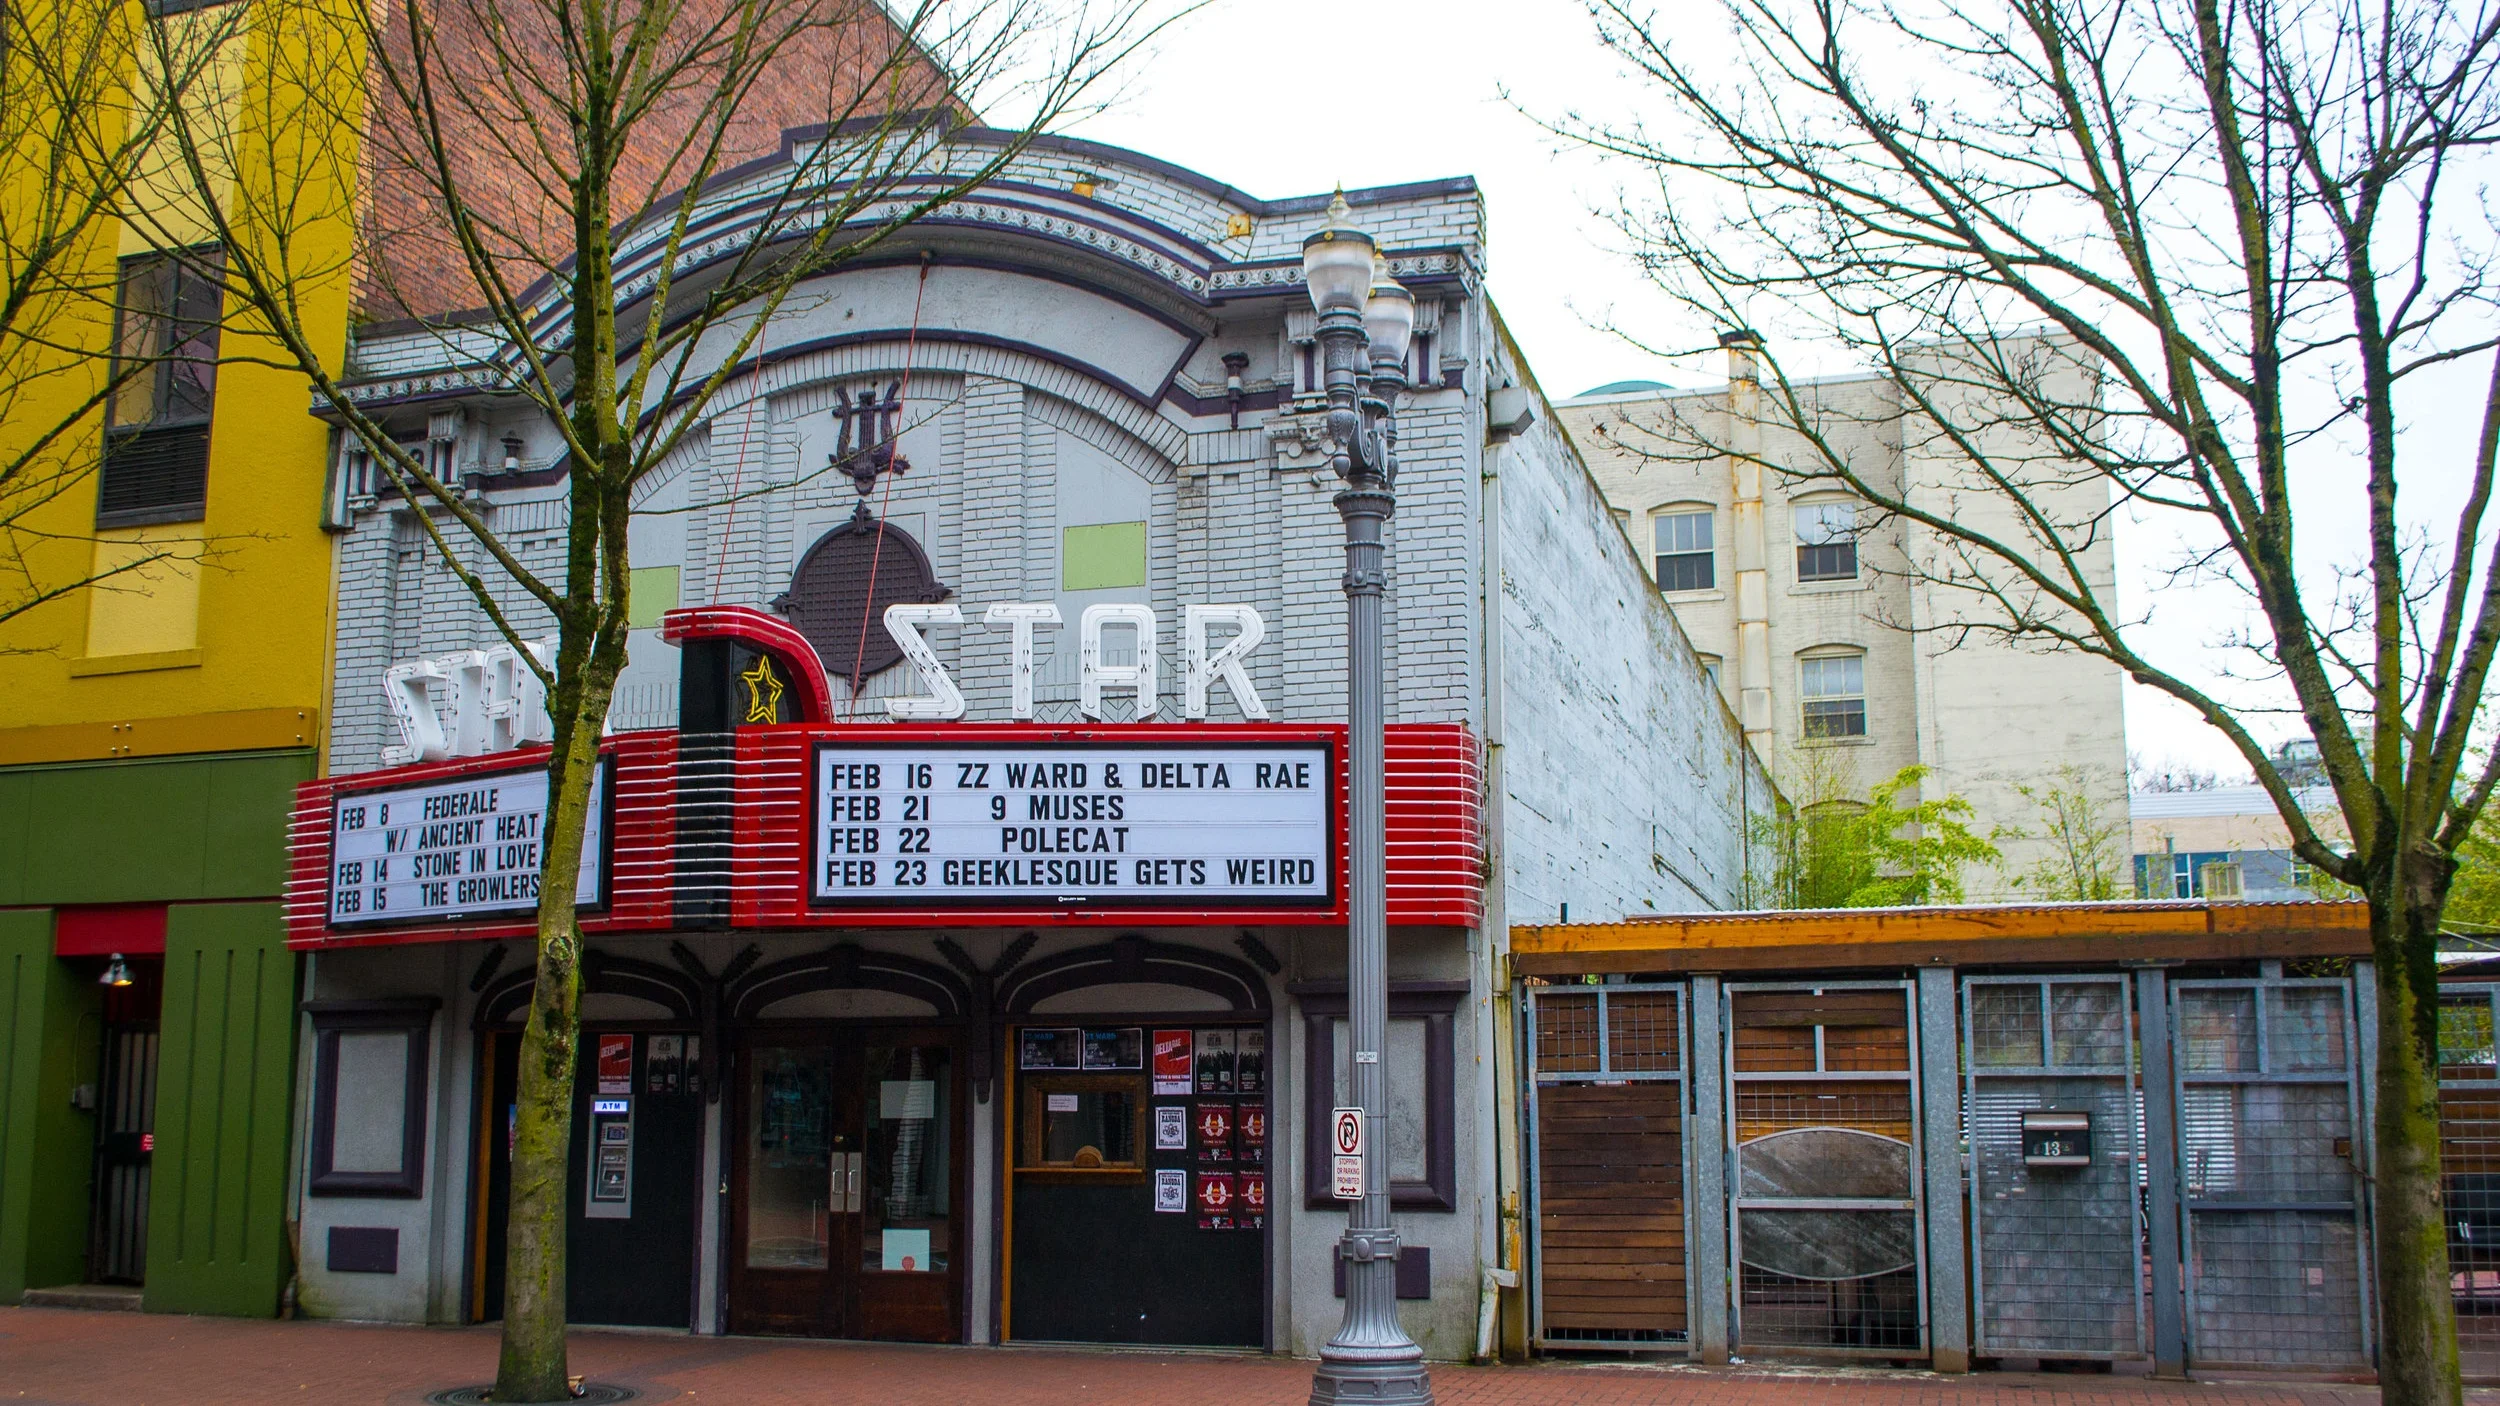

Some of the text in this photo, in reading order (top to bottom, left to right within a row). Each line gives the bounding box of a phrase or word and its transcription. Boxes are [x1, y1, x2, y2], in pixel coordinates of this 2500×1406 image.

[884, 604, 1270, 720] STAR
[381, 632, 612, 765] STA
[832, 763, 1308, 790] FEB 16 ZZ WARD & DELTA RAE
[341, 789, 498, 831] FEB 8 FEDERALE
[832, 795, 1123, 821] FEB 21 9 MUSES
[387, 813, 538, 853] W/ ANCIENT HEAT
[830, 828, 1128, 853] FEB 22 POLECAT
[338, 843, 536, 886] FEB 14 STONE IN LOVE
[827, 859, 1314, 886] FEB 23 GEEKLESQUE GETS WEIRD
[336, 873, 539, 914] FEB 15 THE GROWLERS
[2044, 1141, 2060, 1156] 13
